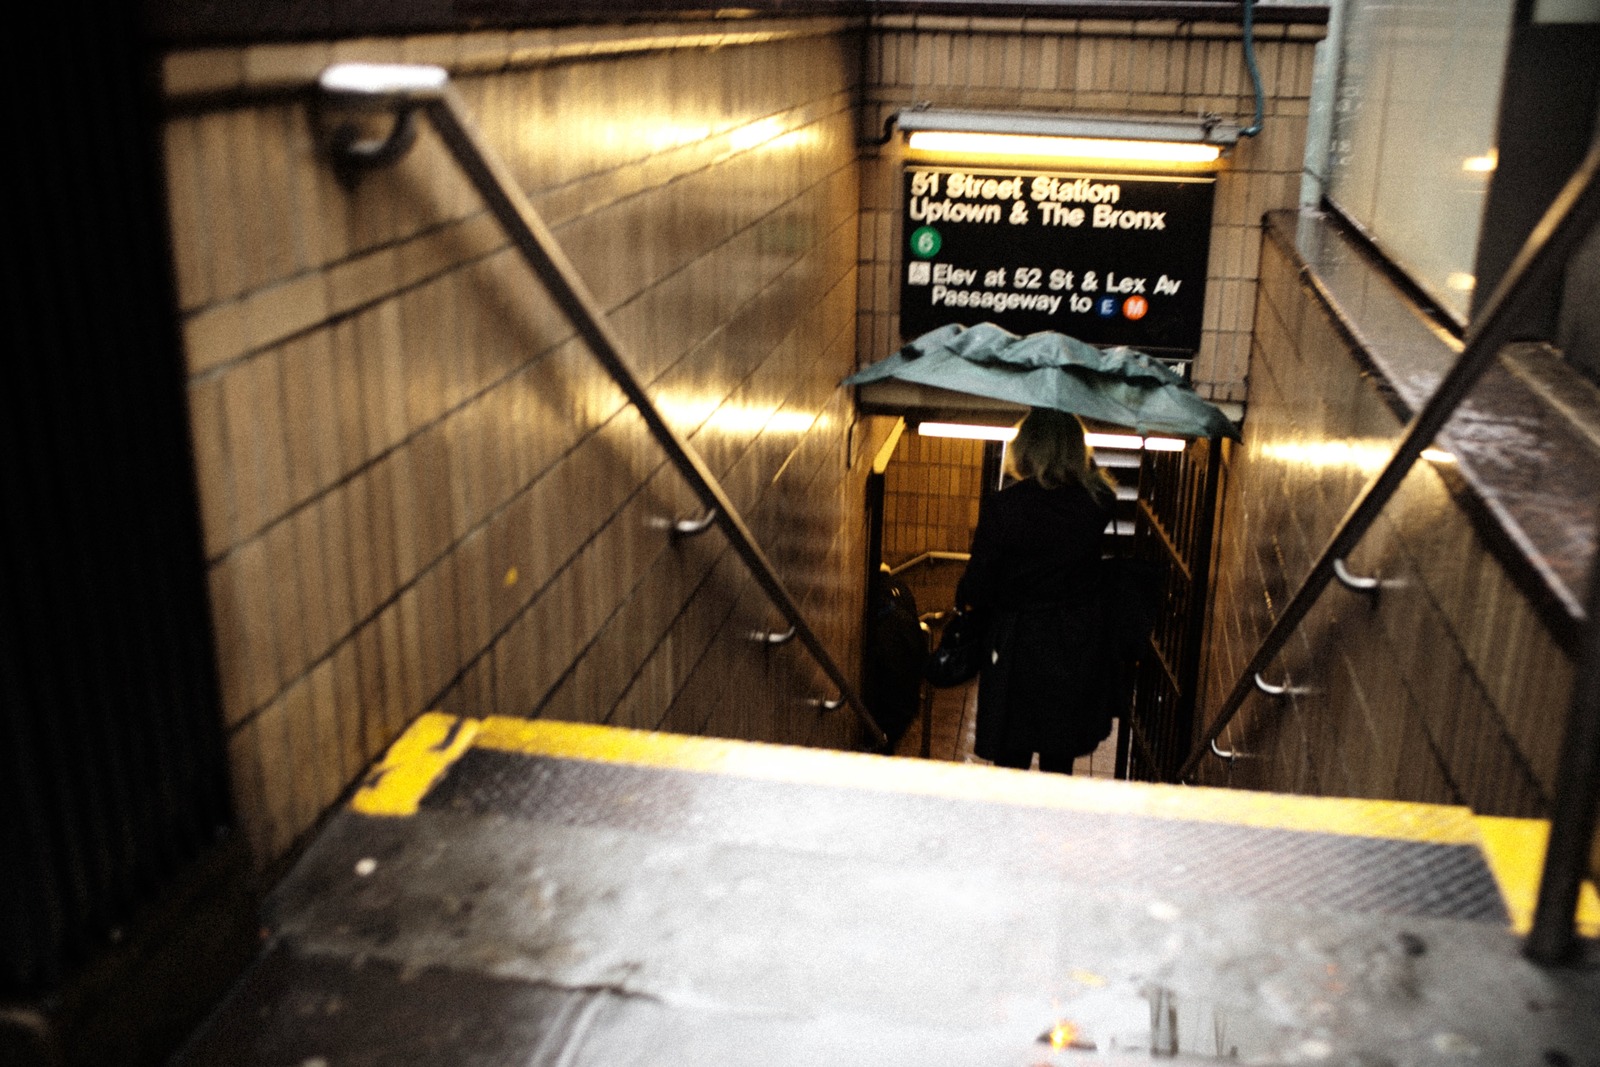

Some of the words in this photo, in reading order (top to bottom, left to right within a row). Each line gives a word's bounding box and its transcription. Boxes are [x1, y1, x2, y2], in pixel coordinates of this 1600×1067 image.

[911, 171, 939, 196] 51
[946, 172, 1023, 199] Street
[1031, 176, 1120, 203] Station
[910, 196, 1001, 224] Uptown
[1009, 200, 1029, 226] &
[1037, 202, 1085, 227] The
[1092, 204, 1166, 230] Bronx
[918, 231, 934, 254] 6
[932, 263, 977, 286] Elev
[984, 267, 1007, 288] at
[1013, 267, 1042, 290] 52
[1049, 268, 1075, 291] St
[1081, 270, 1099, 292] &
[1106, 272, 1146, 294] Lex
[1153, 274, 1182, 296] Av
[931, 285, 1062, 315] Passageway
[1069, 292, 1093, 314] to
[1100, 299, 1114, 315] E
[1126, 300, 1145, 317] M
